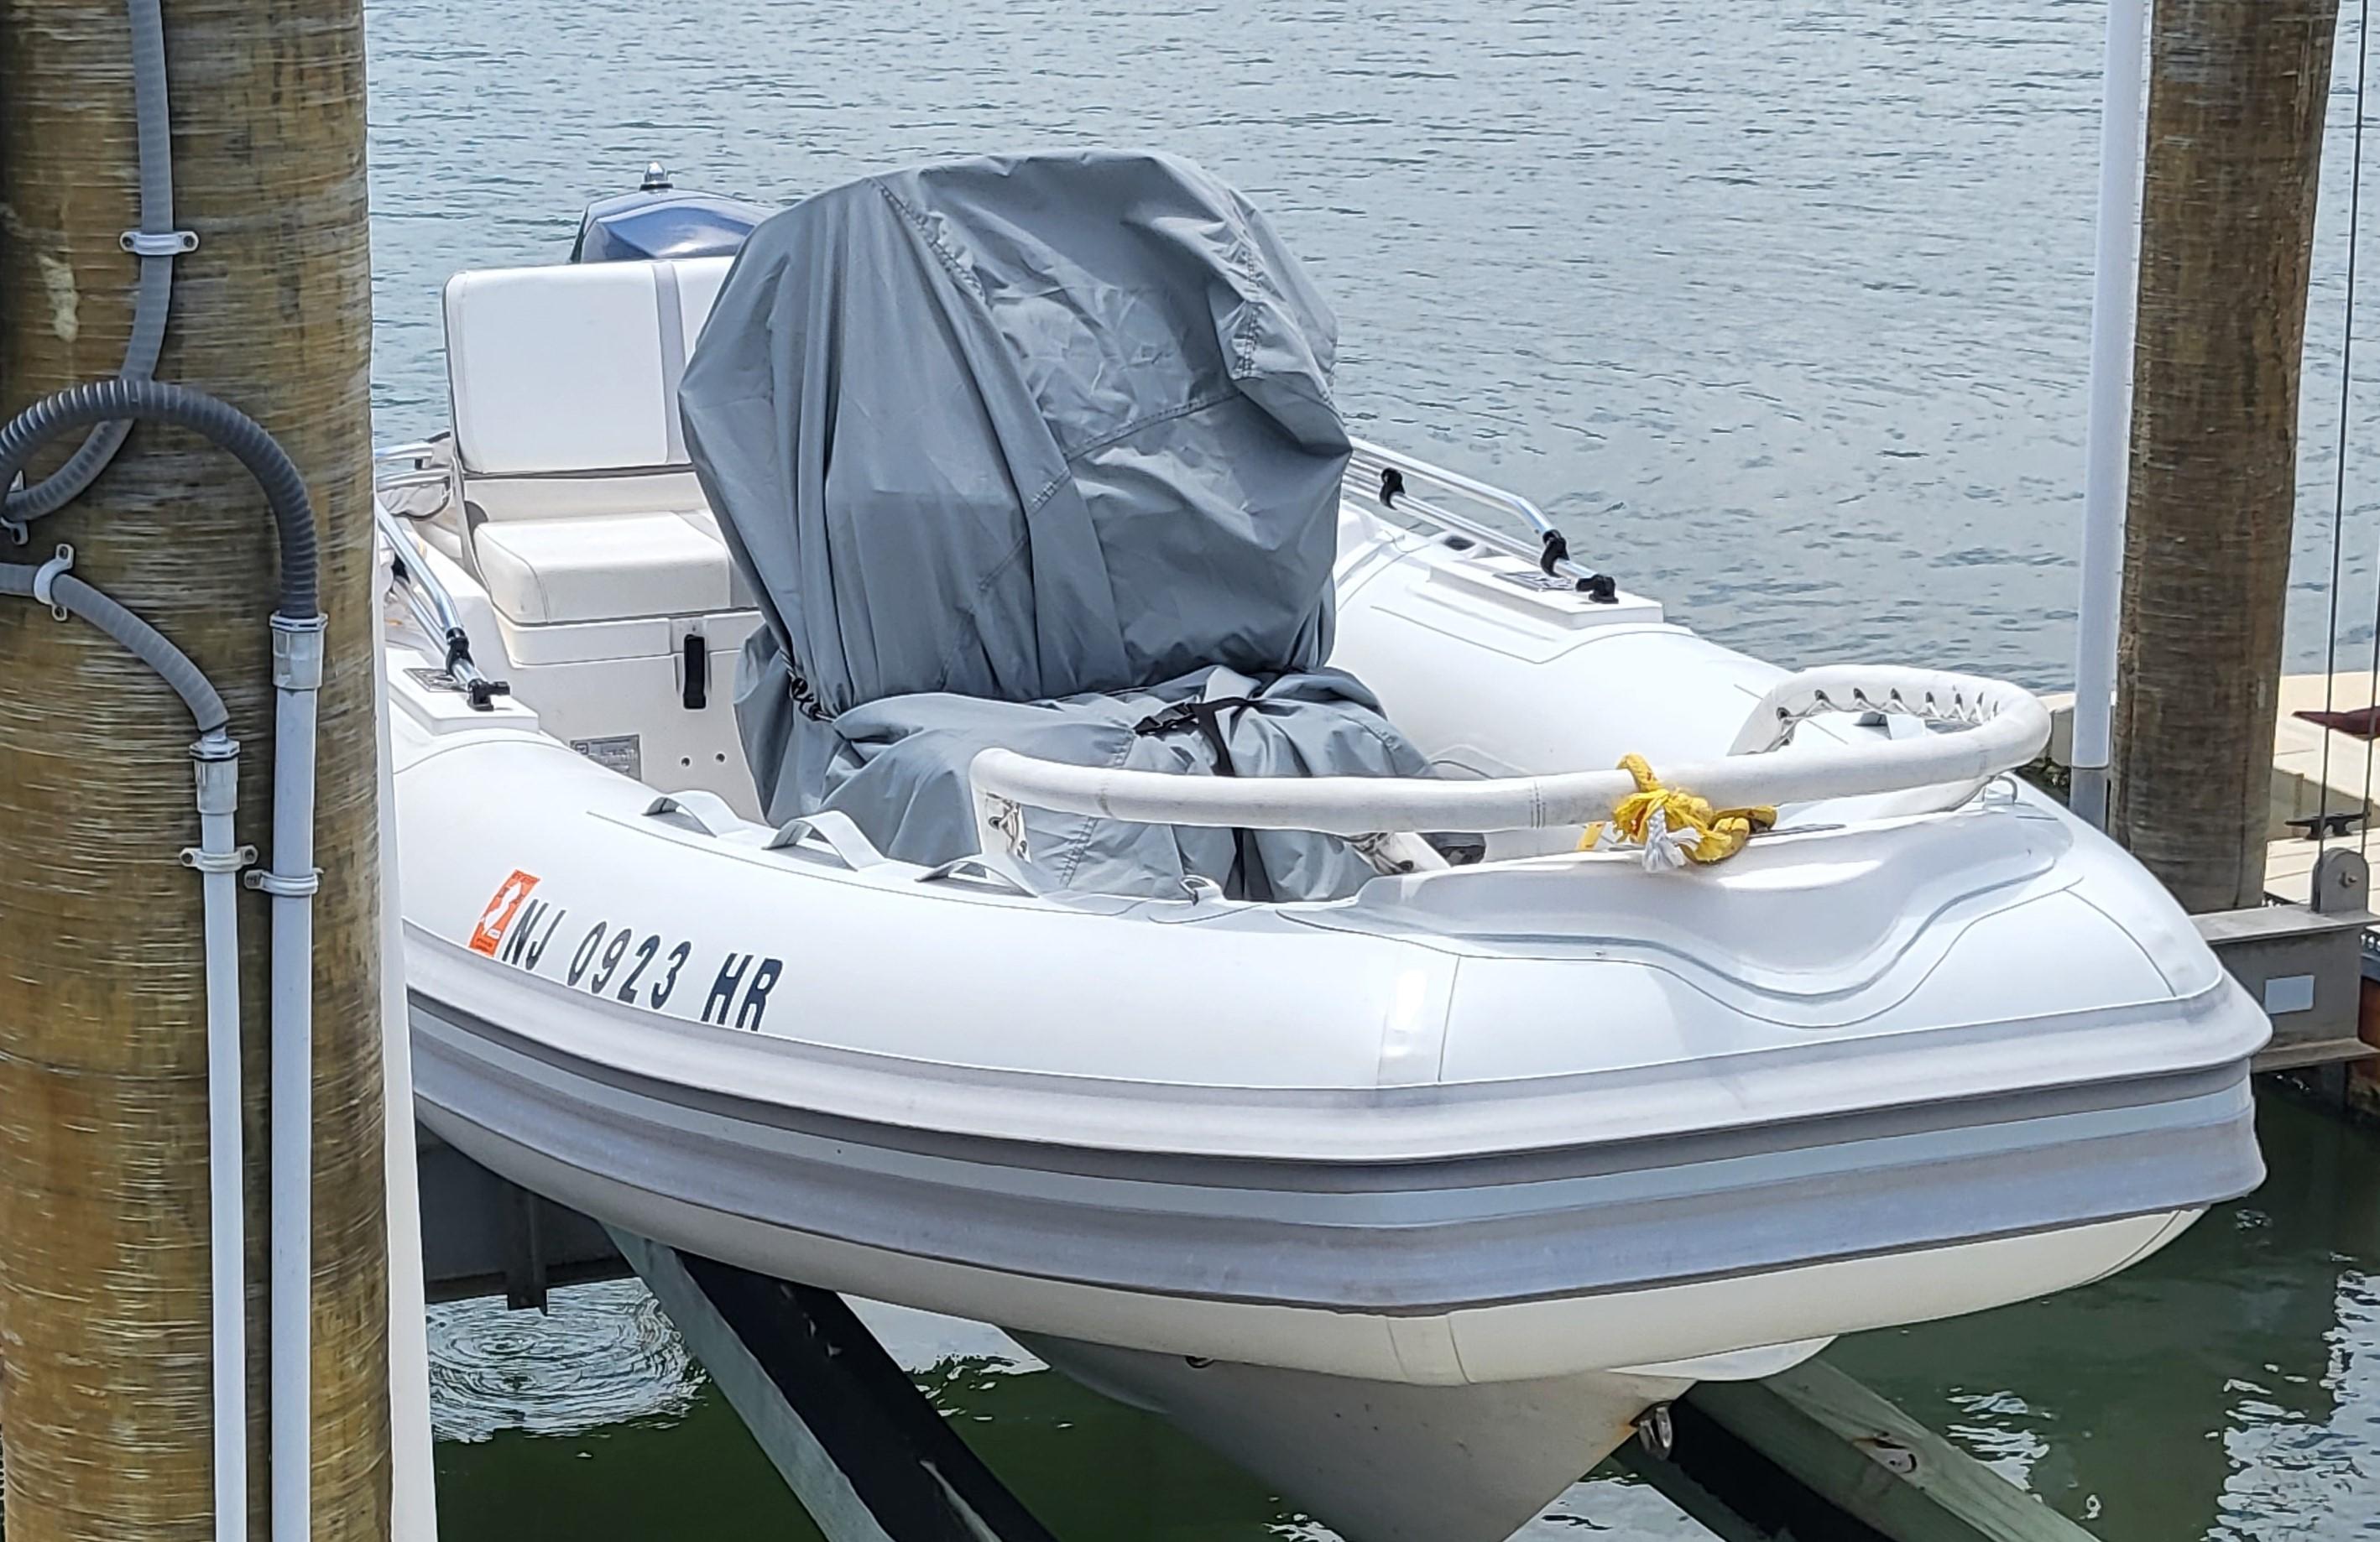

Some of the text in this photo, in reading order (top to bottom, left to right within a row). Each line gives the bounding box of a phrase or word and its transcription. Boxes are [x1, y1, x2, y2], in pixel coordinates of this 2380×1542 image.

[502, 899, 783, 1032] NJ 0923 HR
